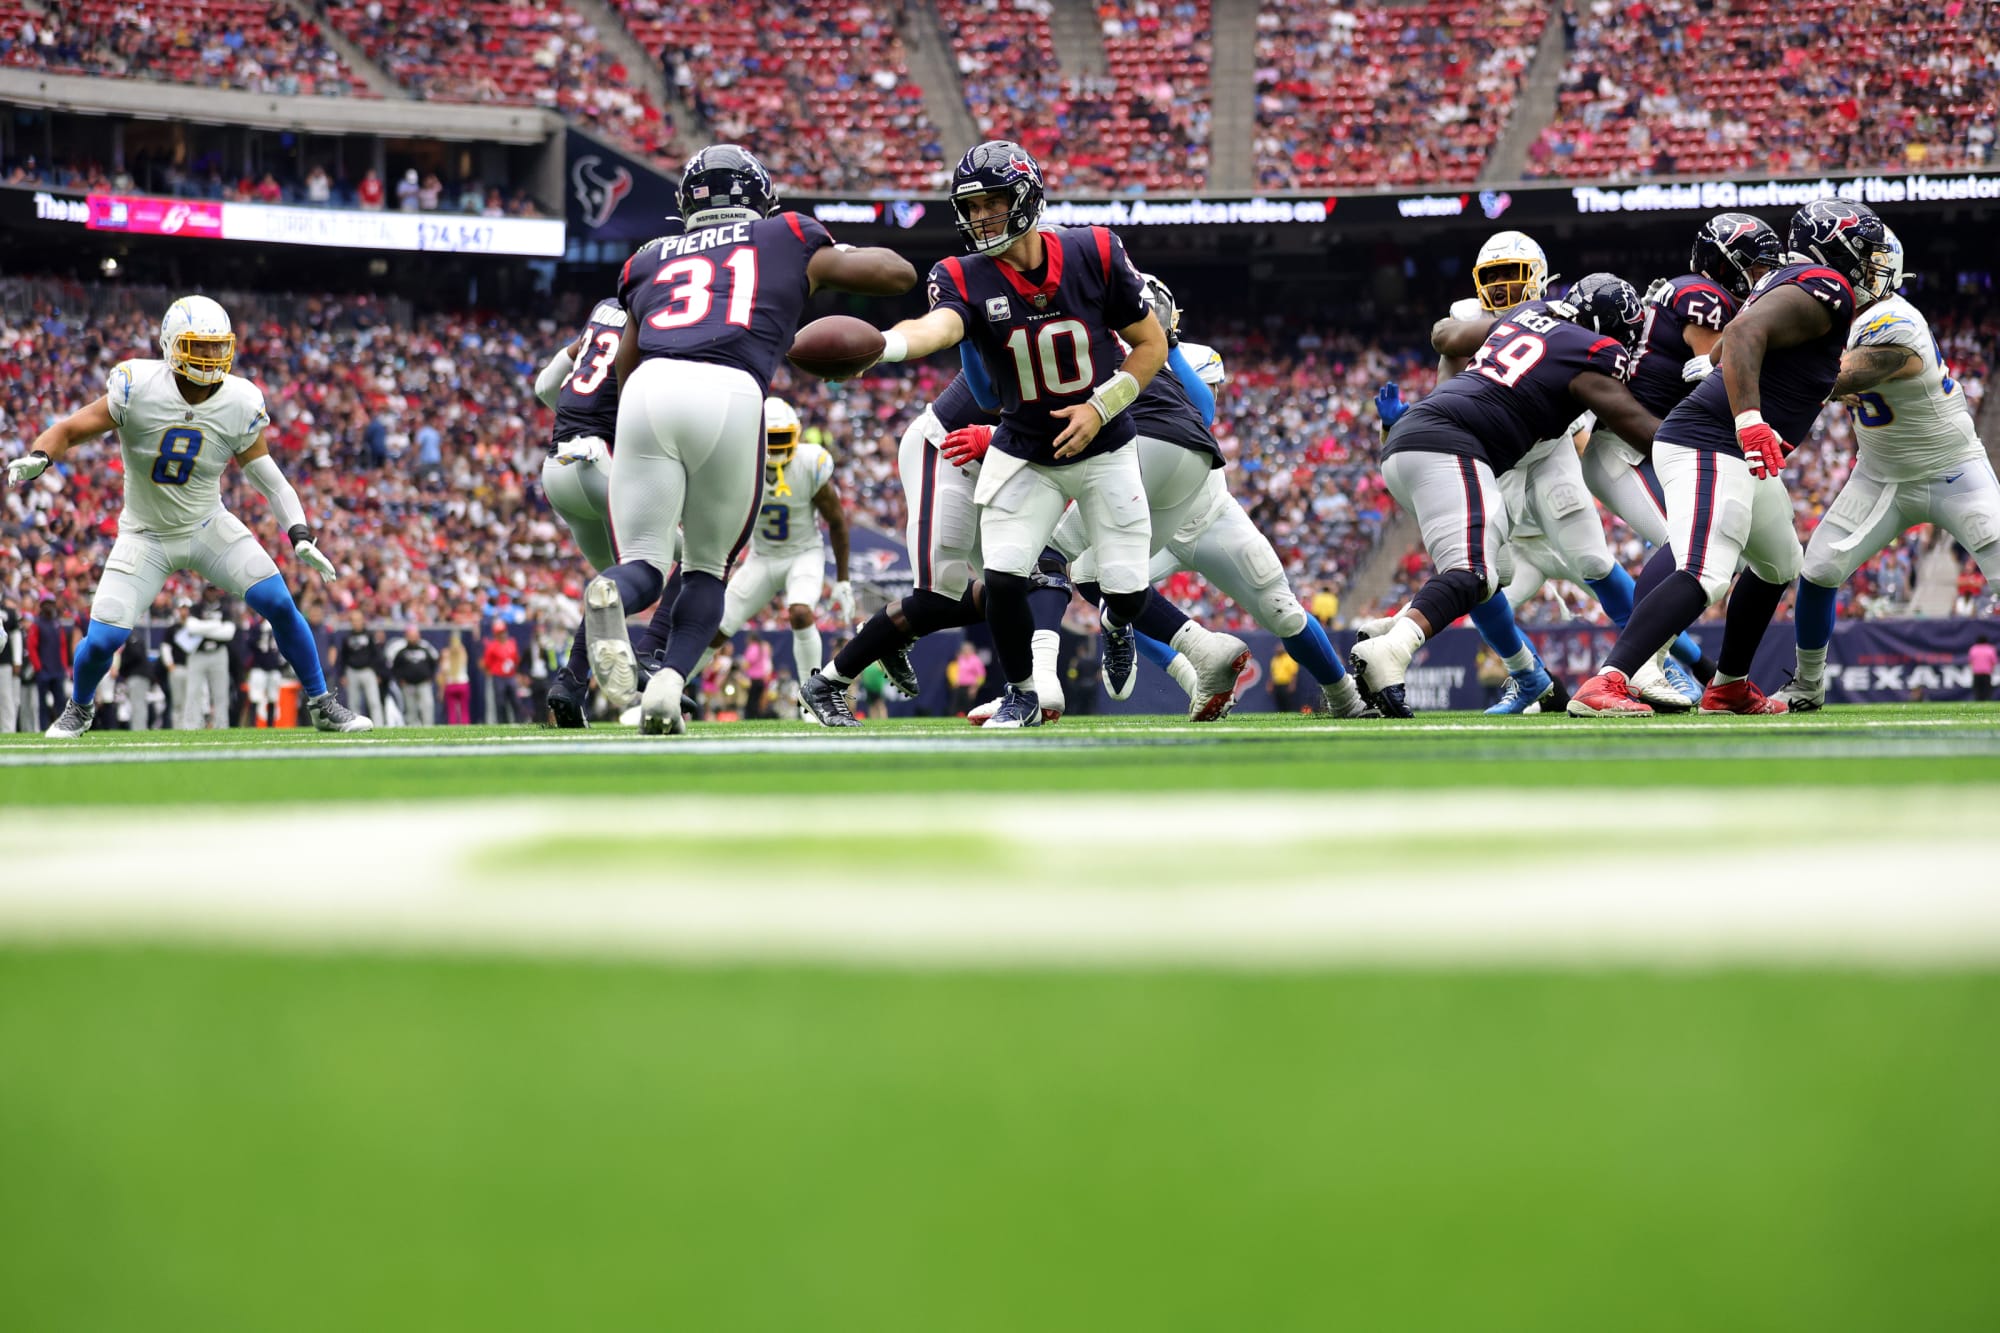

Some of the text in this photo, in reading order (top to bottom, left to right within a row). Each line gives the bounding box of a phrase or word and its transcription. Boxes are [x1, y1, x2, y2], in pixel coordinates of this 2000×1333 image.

[34, 192, 67, 220] The
[1572, 186, 1620, 213] The
[1621, 183, 1700, 212] official
[1701, 181, 1738, 209] 5G
[1738, 180, 1837, 207] network
[1837, 177, 1867, 201] of
[1866, 176, 1905, 202] the
[696, 214, 719, 223] INSPIRE
[660, 222, 750, 260] PIERCE
[647, 246, 759, 330] 31
[1027, 311, 1060, 321] TEXANS
[1687, 300, 1722, 330] 54
[1004, 317, 1096, 402] 10
[152, 426, 204, 486] 8
[760, 502, 790, 542] 3
